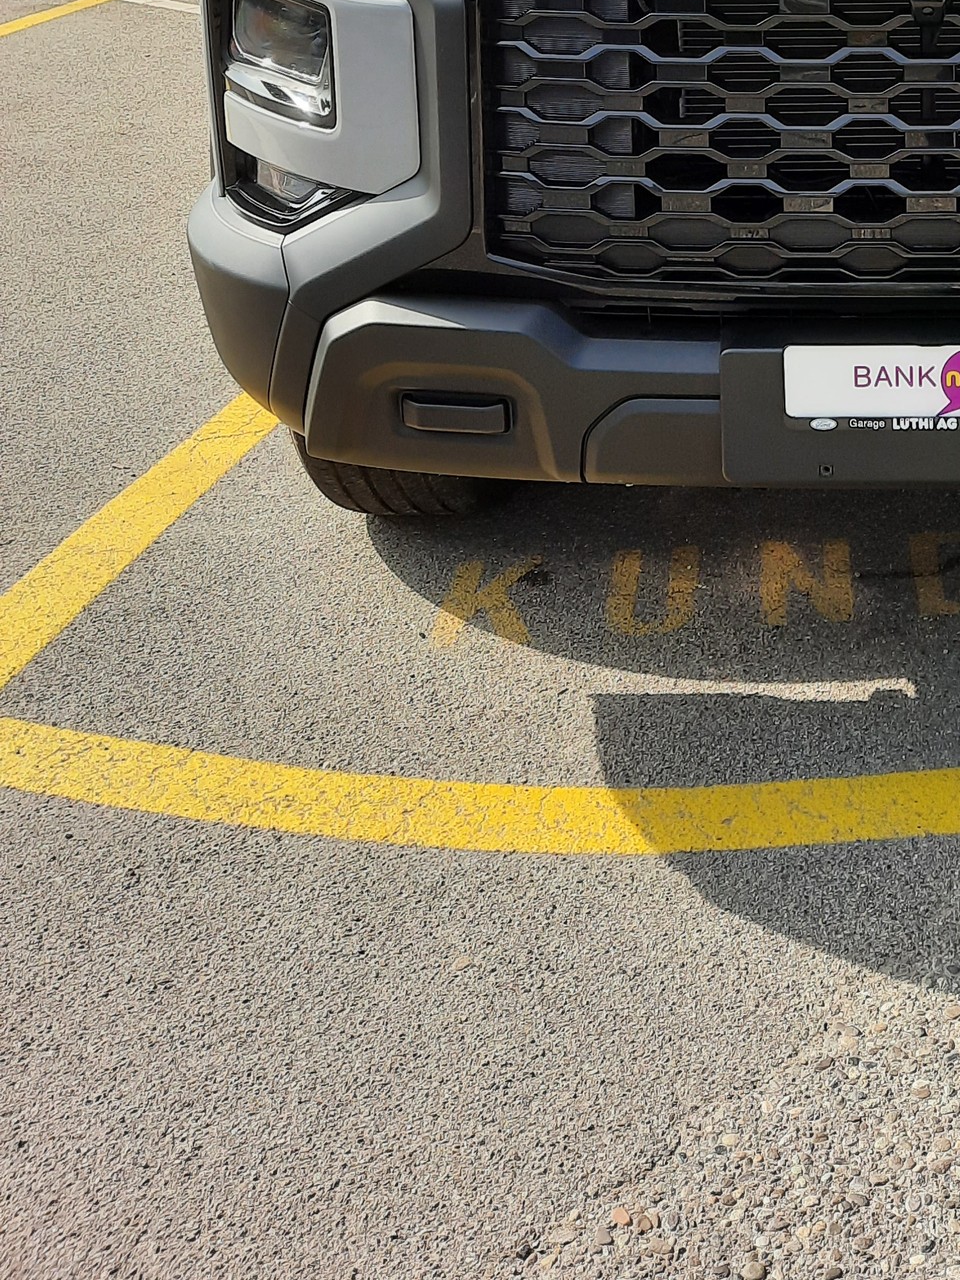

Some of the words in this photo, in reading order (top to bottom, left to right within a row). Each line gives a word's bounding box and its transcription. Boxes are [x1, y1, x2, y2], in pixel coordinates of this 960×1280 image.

[853, 365, 937, 388] BANK
[849, 418, 885, 431] Garage
[936, 417, 959, 431] AG
